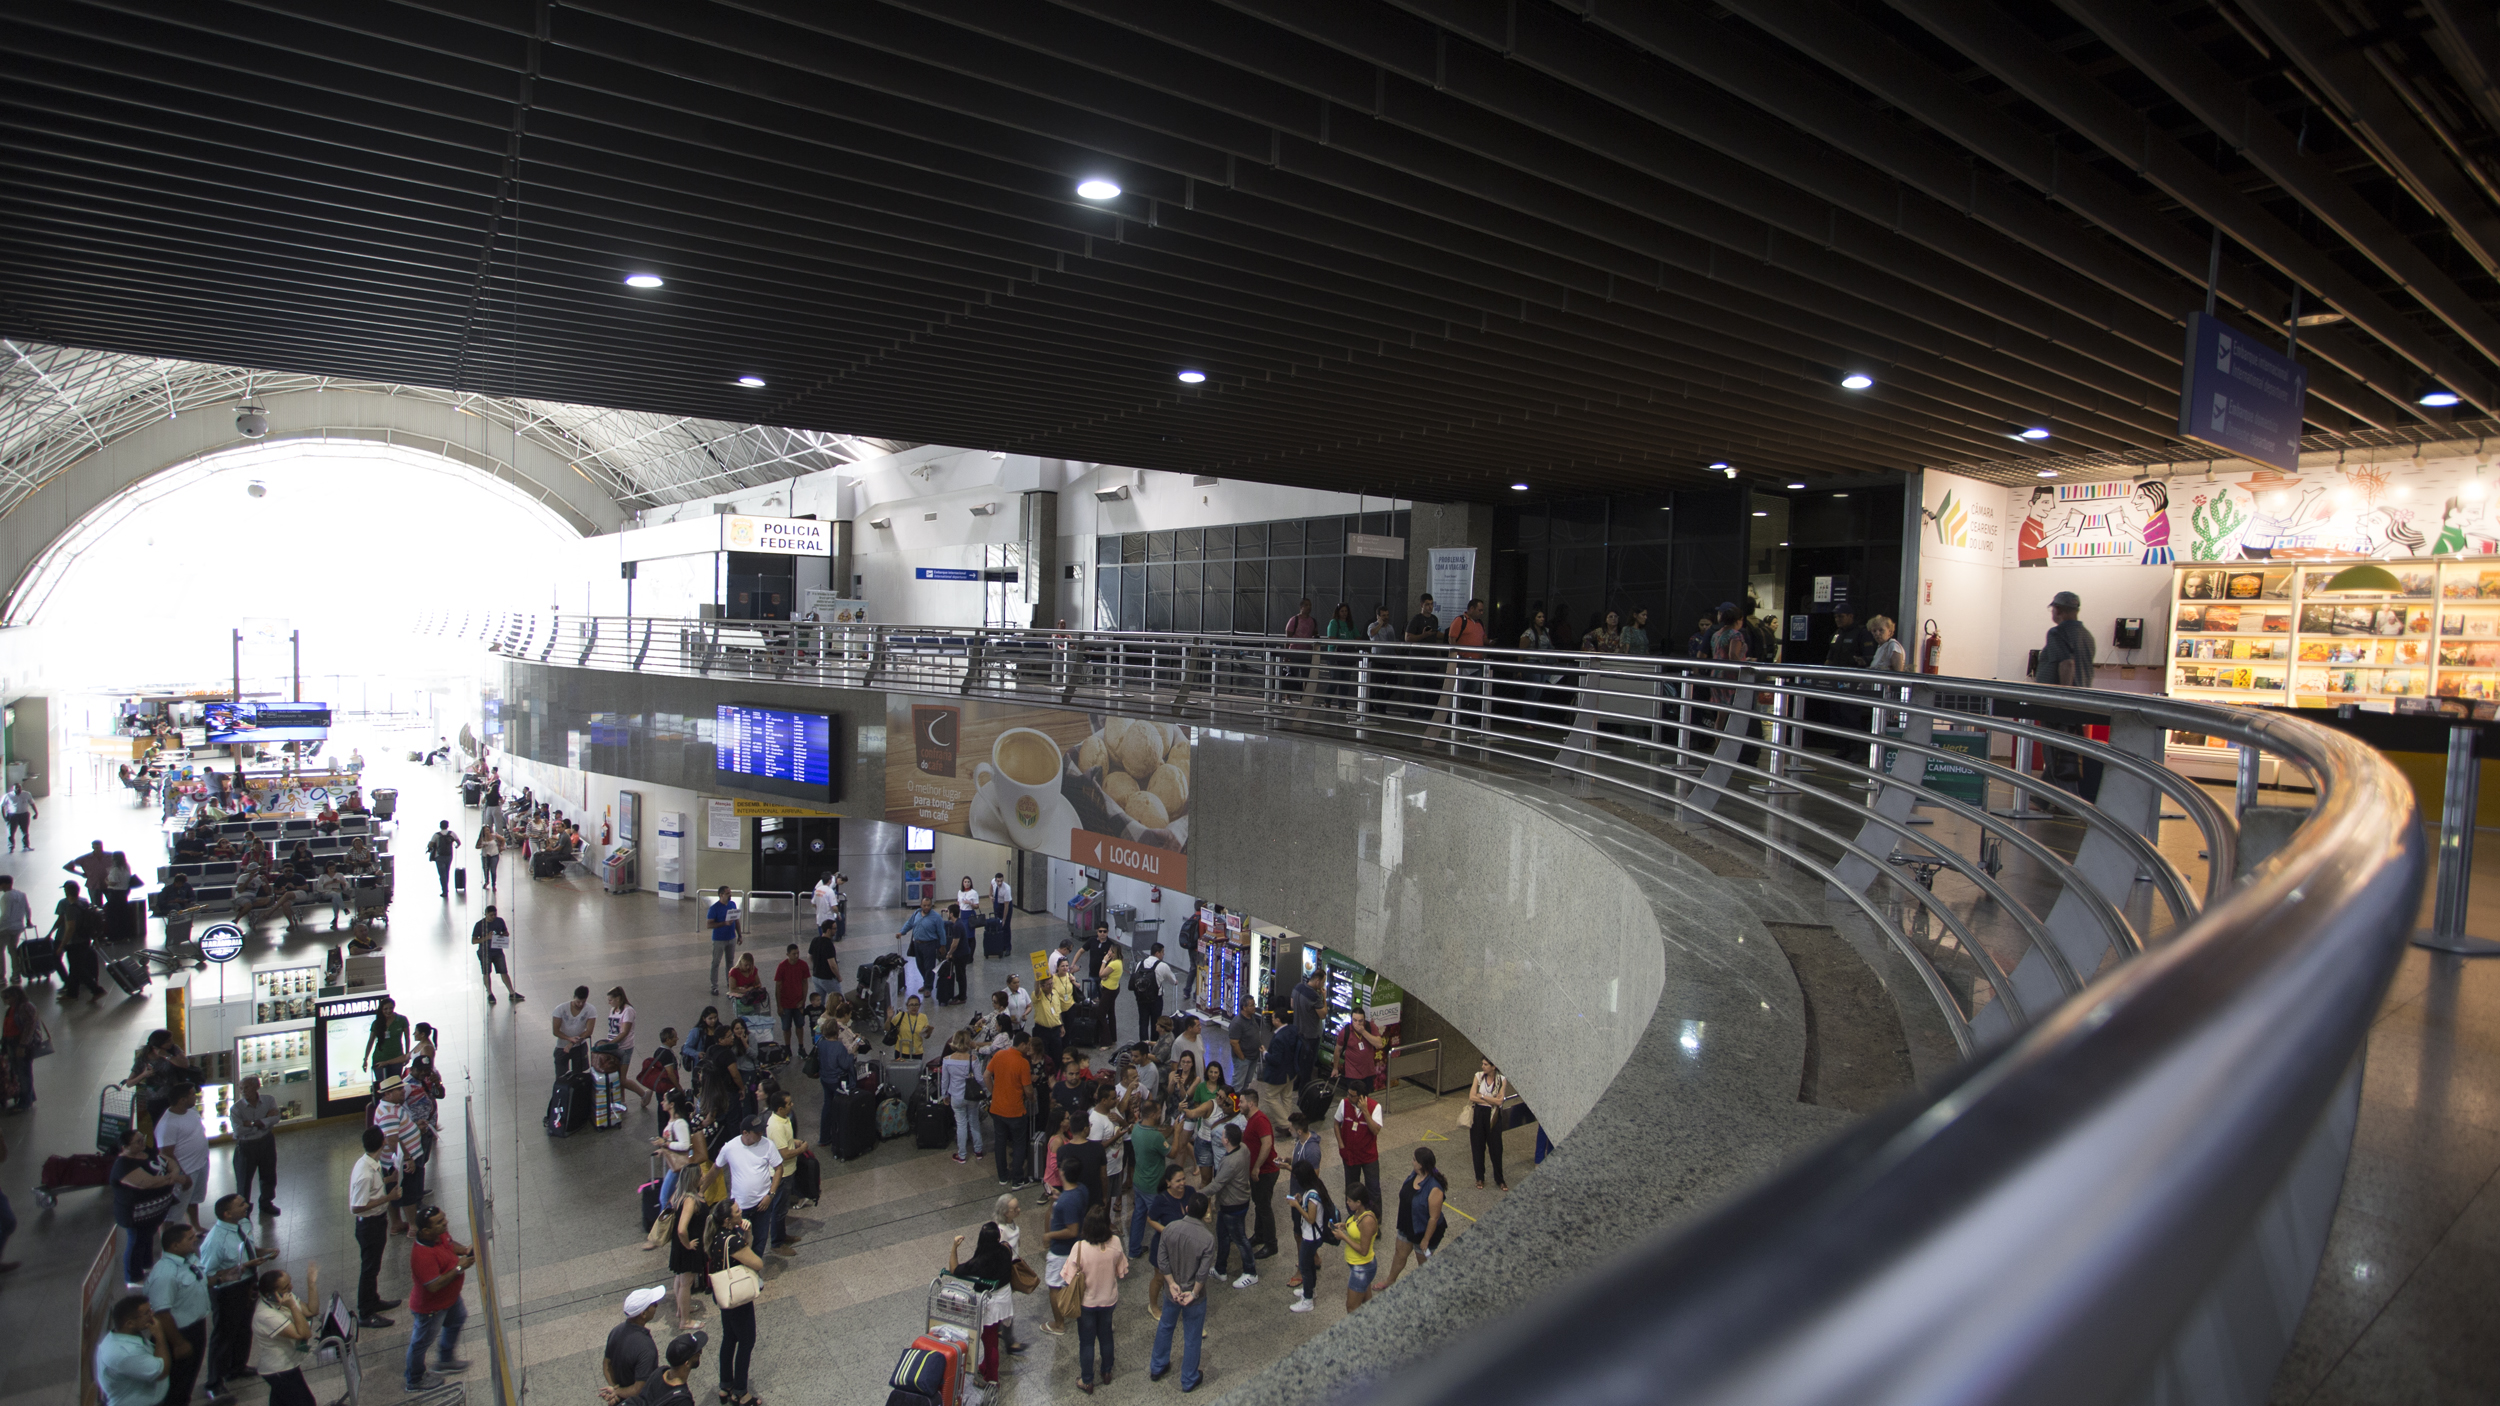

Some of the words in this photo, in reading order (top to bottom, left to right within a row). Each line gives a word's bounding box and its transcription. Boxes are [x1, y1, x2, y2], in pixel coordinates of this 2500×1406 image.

[1970, 502, 1994, 518] CÂMARA
[1970, 521, 1998, 537] CEARENSE
[760, 537, 823, 551] FEDERAL
[1969, 538, 1978, 549] DO
[1978, 539, 1994, 552] LIVRO
[1448, 563, 1469, 571] VIAGEM?
[1942, 744, 1969, 753] Hertz
[907, 780, 914, 791] O
[915, 783, 941, 796] melhor
[942, 786, 962, 801] lugar
[913, 796, 931, 808] para
[931, 798, 955, 811] tomar
[1018, 805, 1037, 814] CLARA
[919, 809, 932, 819] um
[932, 810, 949, 822] café
[1109, 845, 1140, 869] LOGO
[1141, 855, 1159, 875] ALI
[1034, 961, 1047, 969] CVC
[319, 999, 380, 1018] MARAMBAI
